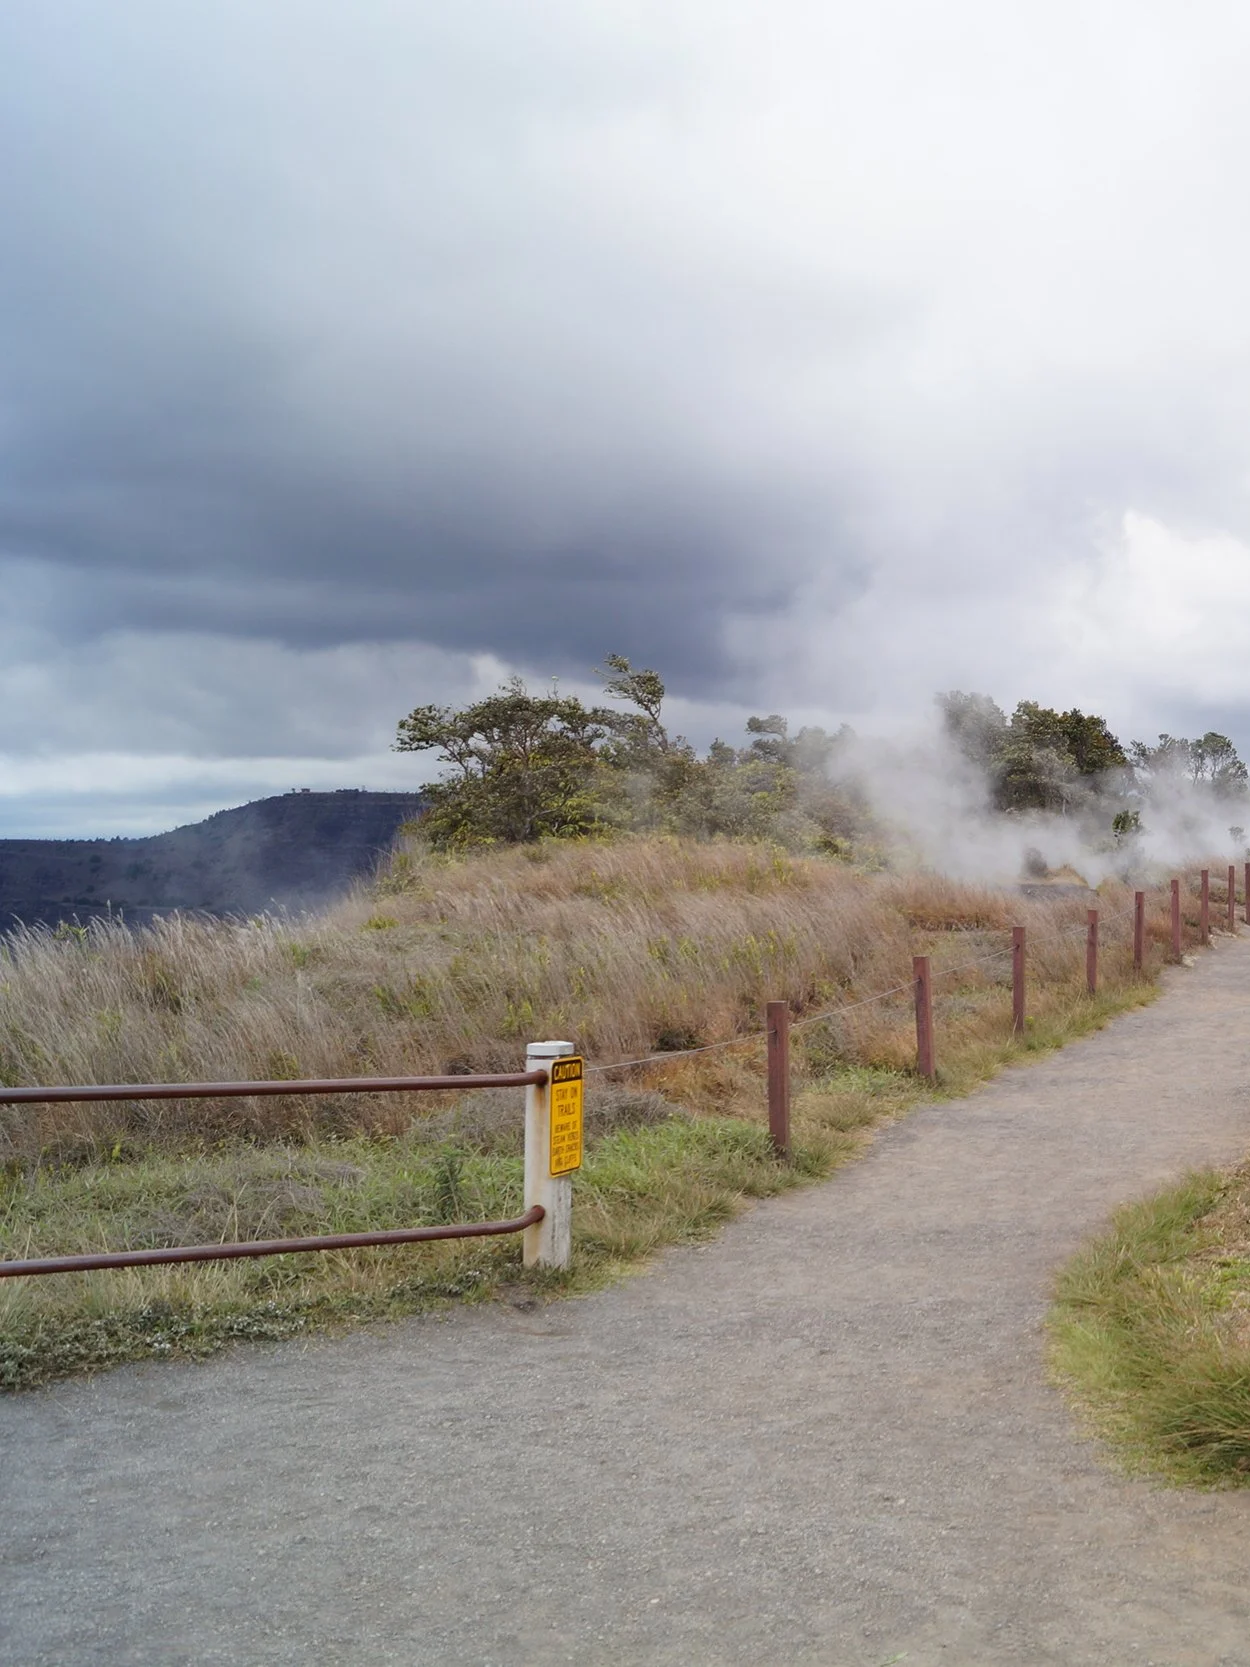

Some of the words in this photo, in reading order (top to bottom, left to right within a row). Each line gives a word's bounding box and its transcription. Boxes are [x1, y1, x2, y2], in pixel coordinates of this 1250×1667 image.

[554, 1063, 580, 1080] CAUTION
[556, 1088, 567, 1101] STAY
[570, 1087, 577, 1099] ON
[557, 1103, 575, 1117] TRAILS
